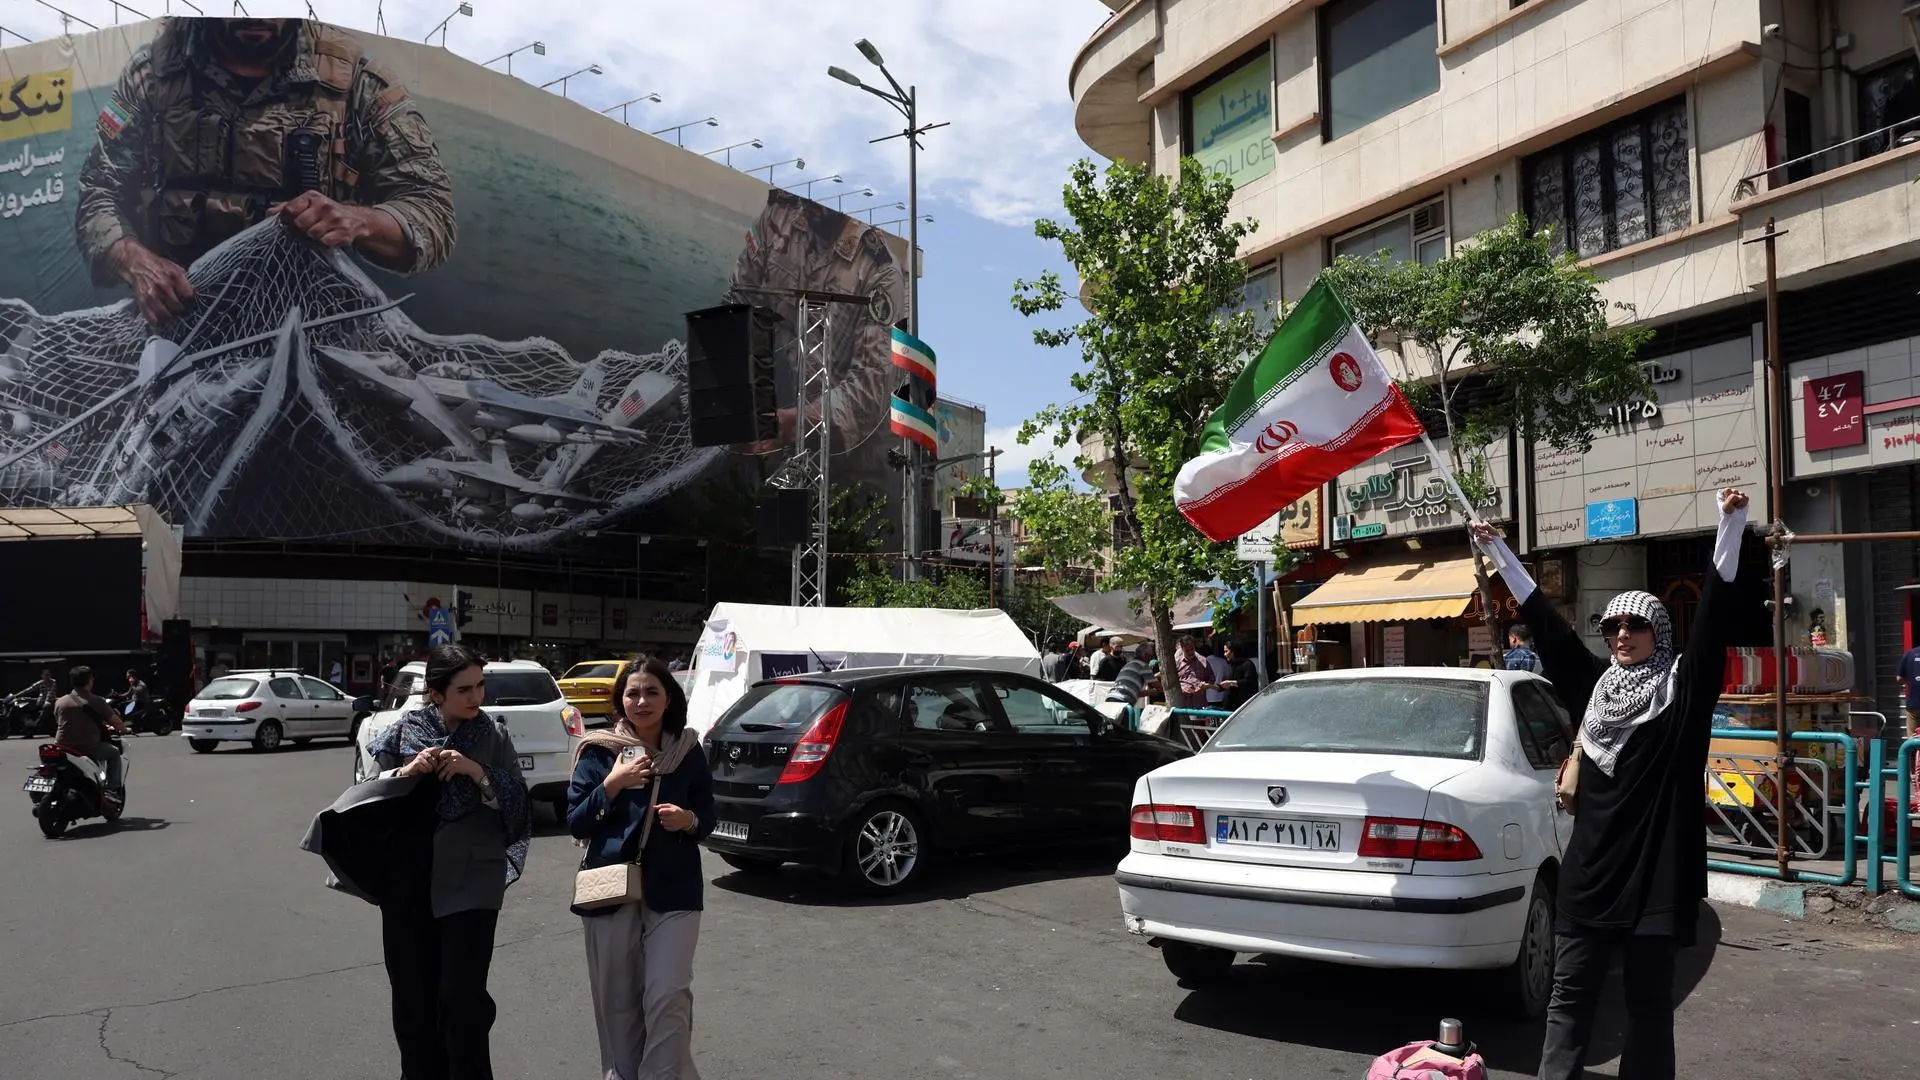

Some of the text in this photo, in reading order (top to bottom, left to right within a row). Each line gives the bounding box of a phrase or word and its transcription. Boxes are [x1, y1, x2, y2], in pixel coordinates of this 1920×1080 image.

[0, 143, 65, 177] سراس
[1203, 136, 1273, 179] POLICE
[0, 172, 64, 219] قلمرو
[582, 378, 595, 391] SW
[1818, 383, 1847, 400] 47
[1658, 433, 1685, 448] پلیس
[1729, 456, 1757, 469] آموزشگاه
[1346, 472, 1395, 511] کلاب
[1539, 522, 1560, 534] سفید
[1560, 517, 1580, 532] آرمان
[1316, 829, 1337, 848] ۱۸
